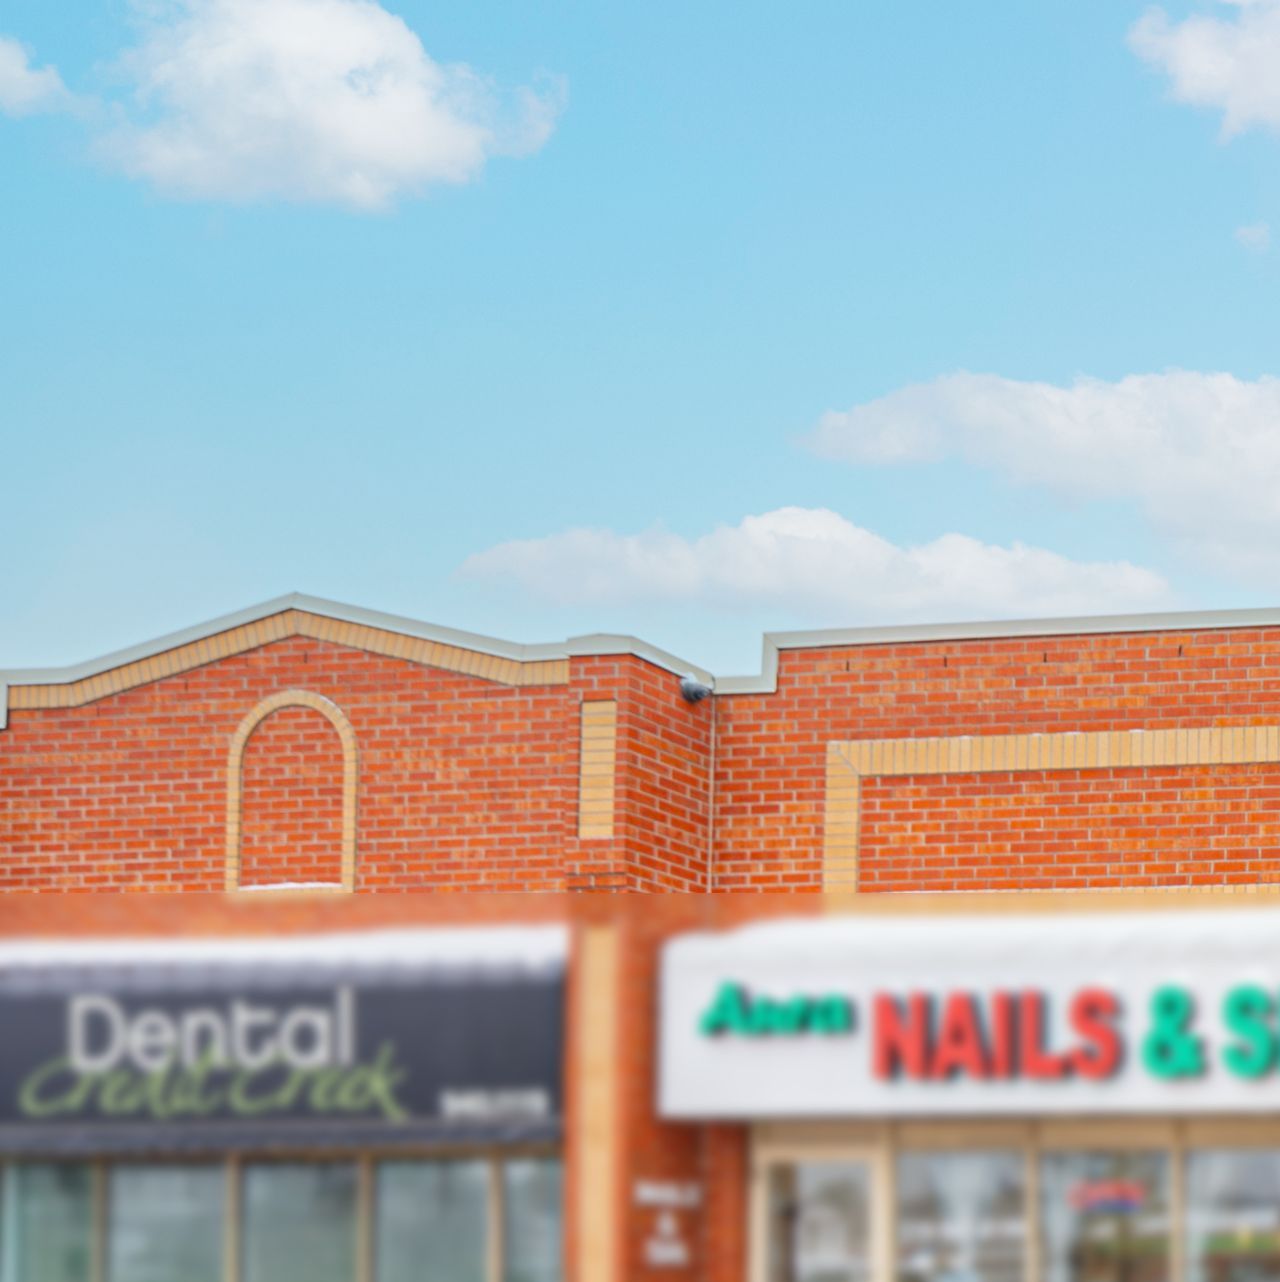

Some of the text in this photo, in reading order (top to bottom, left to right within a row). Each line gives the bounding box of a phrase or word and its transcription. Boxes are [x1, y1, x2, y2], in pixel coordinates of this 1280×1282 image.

[68, 983, 355, 1072] Dental
[871, 988, 1126, 1082] NAILS
[1141, 986, 1207, 1080] &
